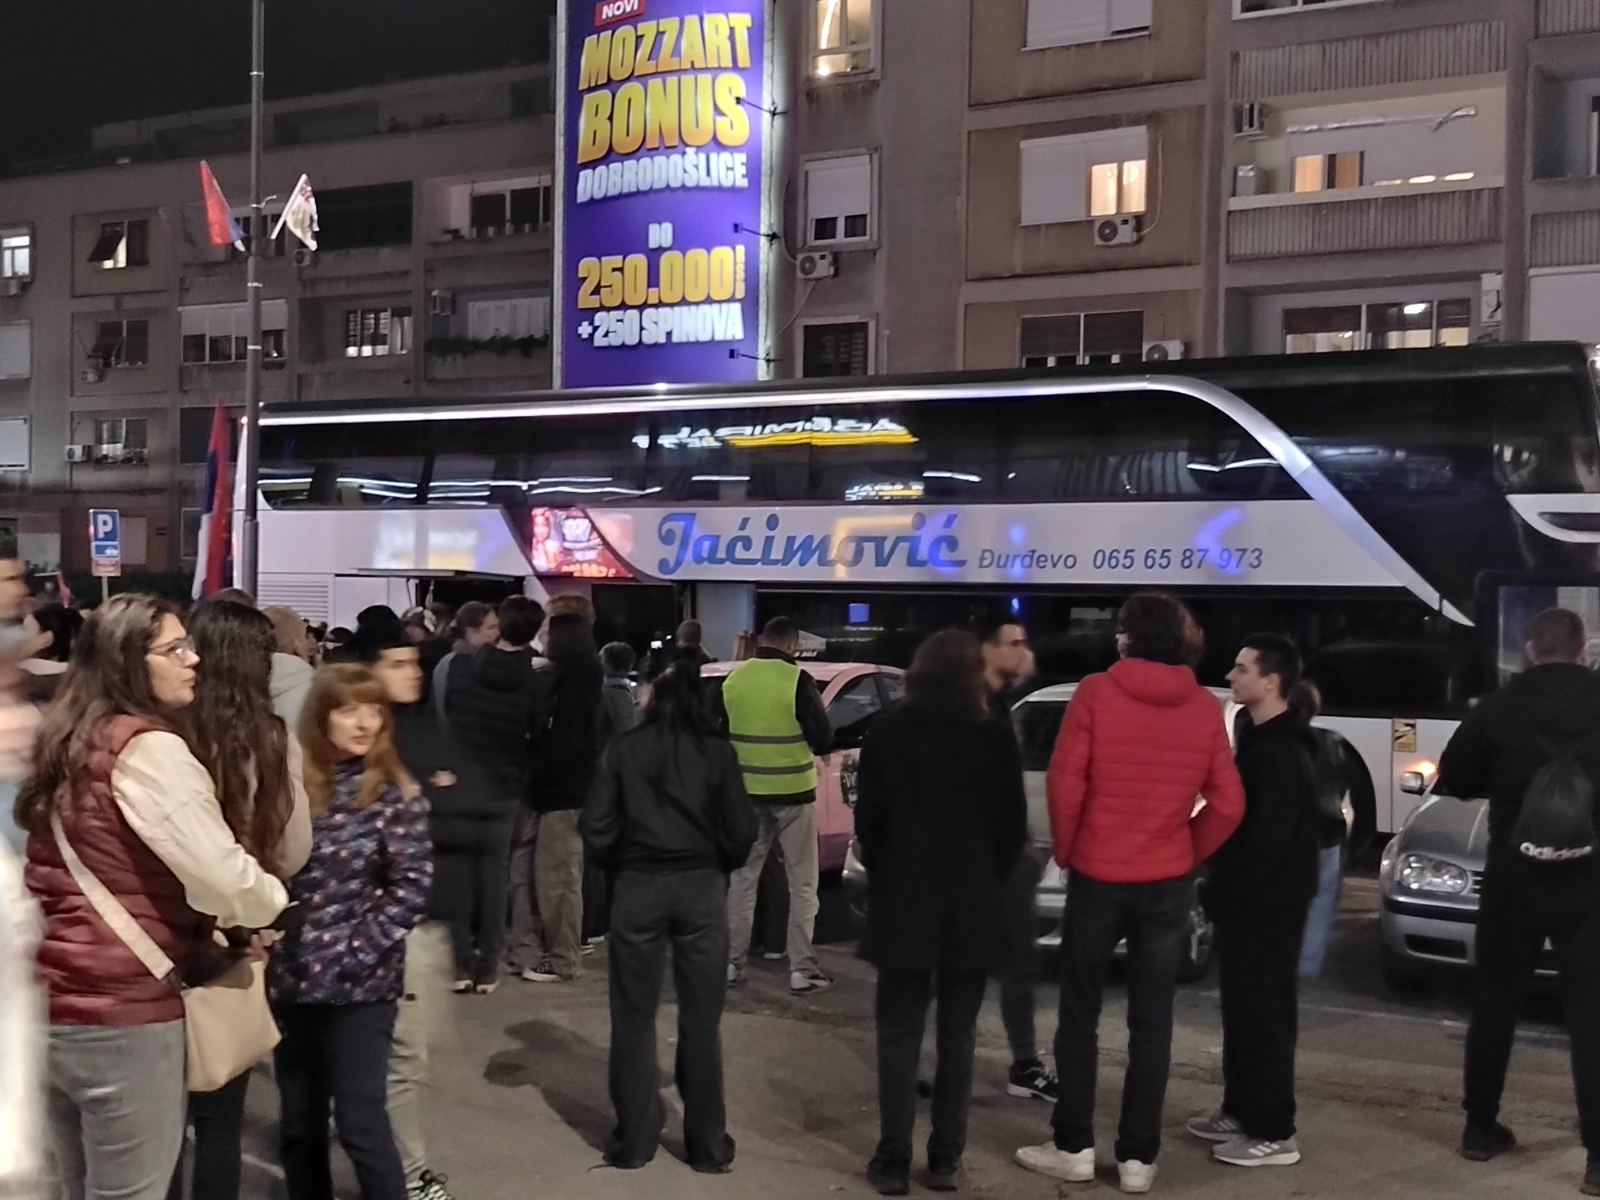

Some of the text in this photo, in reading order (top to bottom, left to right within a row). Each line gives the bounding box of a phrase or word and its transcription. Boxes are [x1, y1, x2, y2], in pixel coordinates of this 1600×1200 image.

[602, 0, 639, 19] NOVI
[578, 13, 752, 90] MOZZART
[577, 72, 750, 164] BONUS
[577, 147, 749, 203] DOBRODOŠLICE
[648, 222, 674, 249] DO
[577, 246, 735, 308] 250.000
[577, 302, 744, 347] +250 SPINOVA
[97, 513, 113, 538] P
[657, 512, 967, 575] Jaćimović
[1093, 548, 1135, 571] 065
[1143, 548, 1172, 570] 65
[1180, 548, 1208, 570] 87
[1219, 547, 1263, 571] 973
